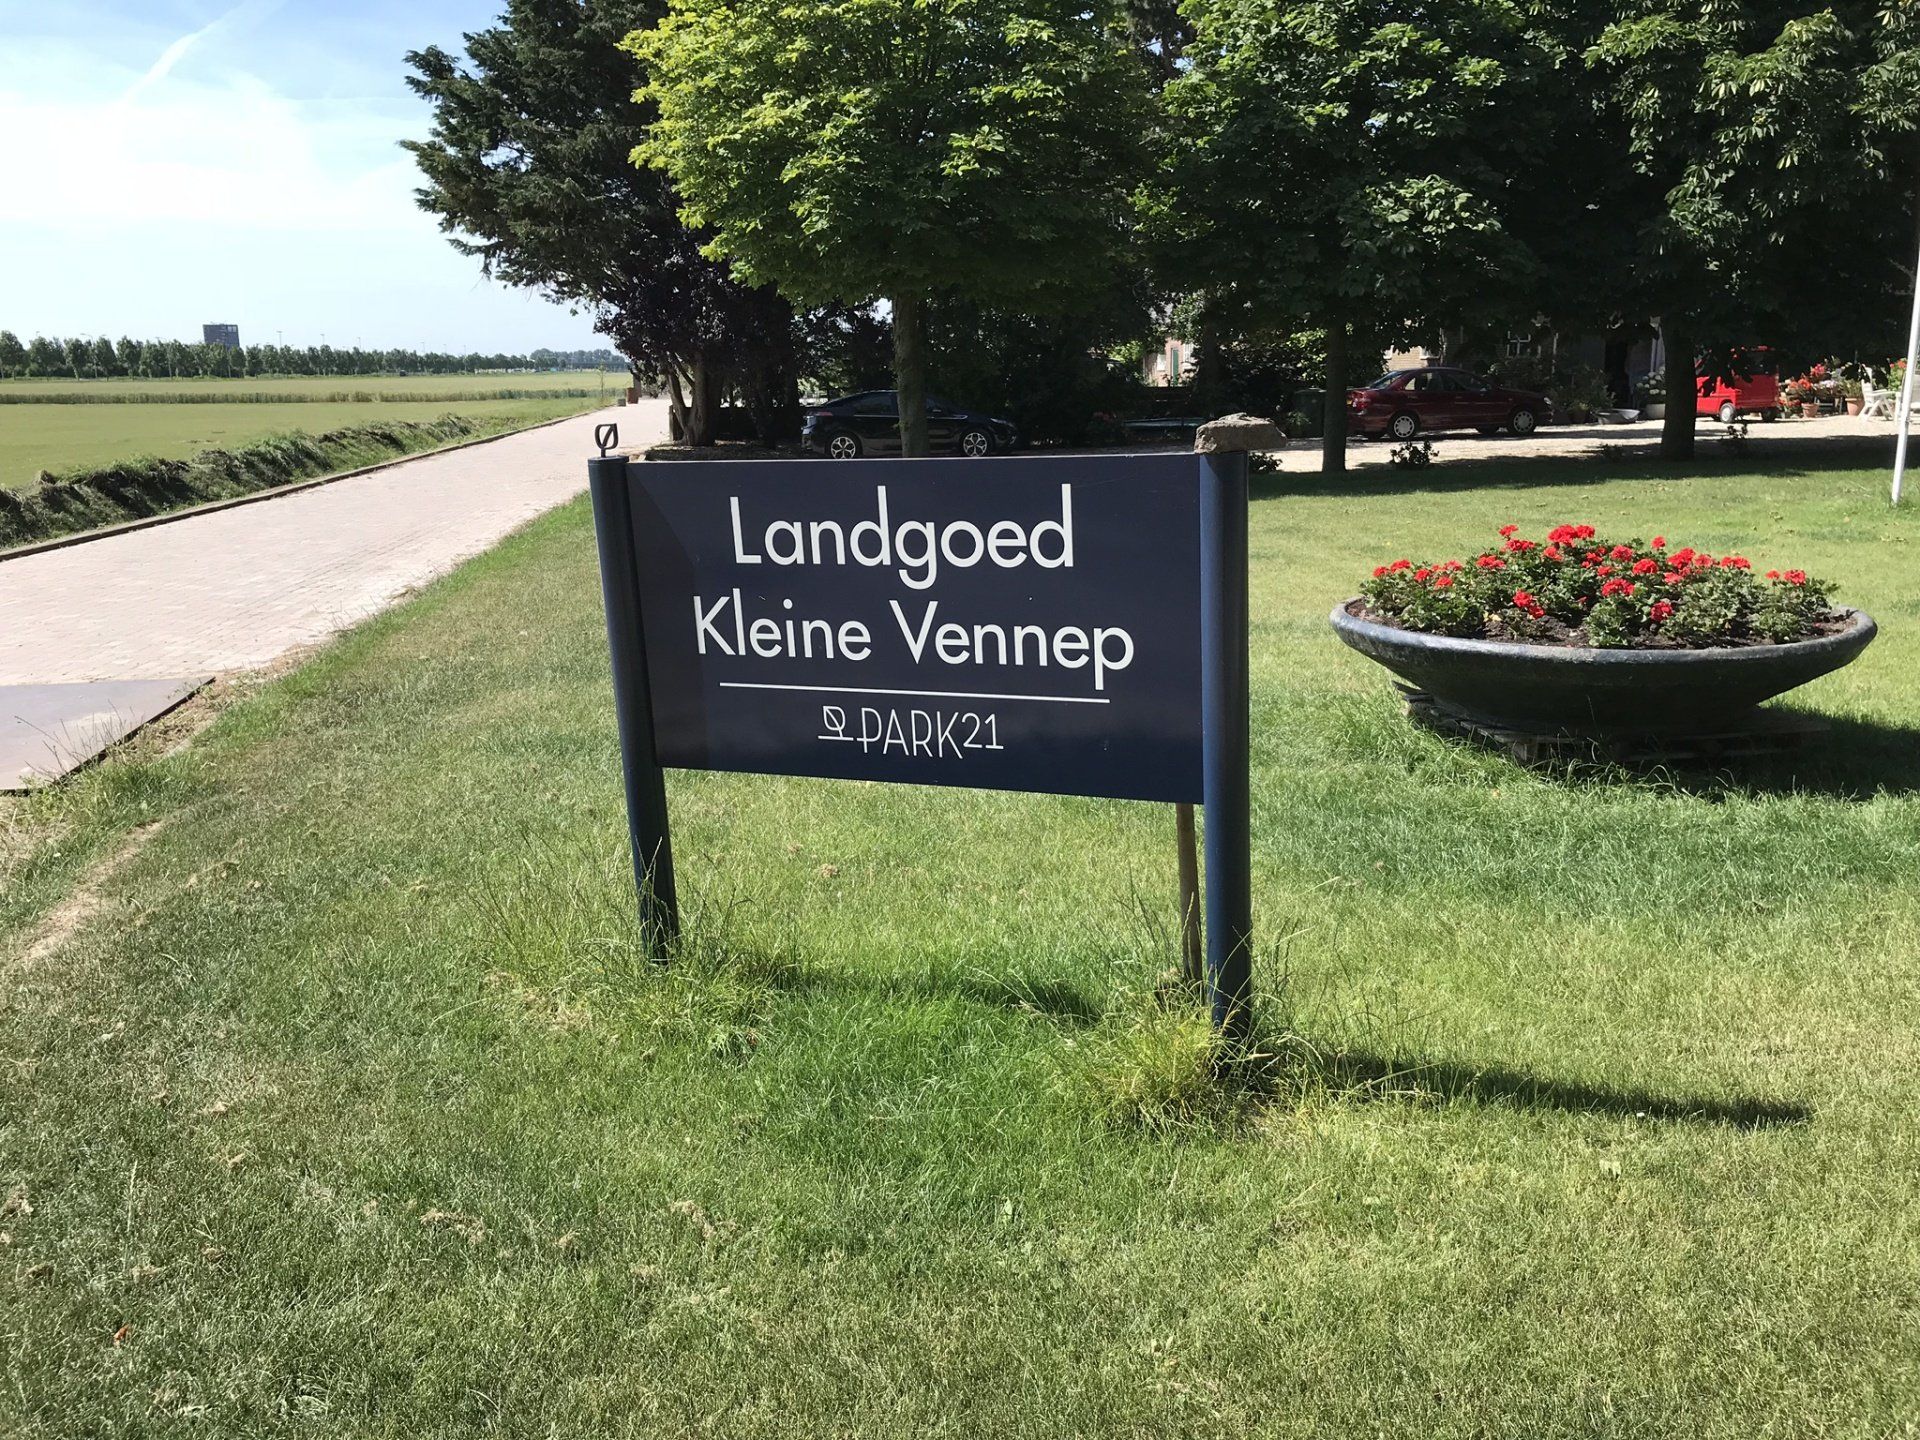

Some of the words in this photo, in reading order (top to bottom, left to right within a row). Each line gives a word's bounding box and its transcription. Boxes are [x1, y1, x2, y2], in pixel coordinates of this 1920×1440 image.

[729, 483, 1074, 588] Landgoed
[693, 587, 872, 661] Kleine
[888, 599, 1135, 691] Vennep
[856, 707, 1004, 759] PARK21
